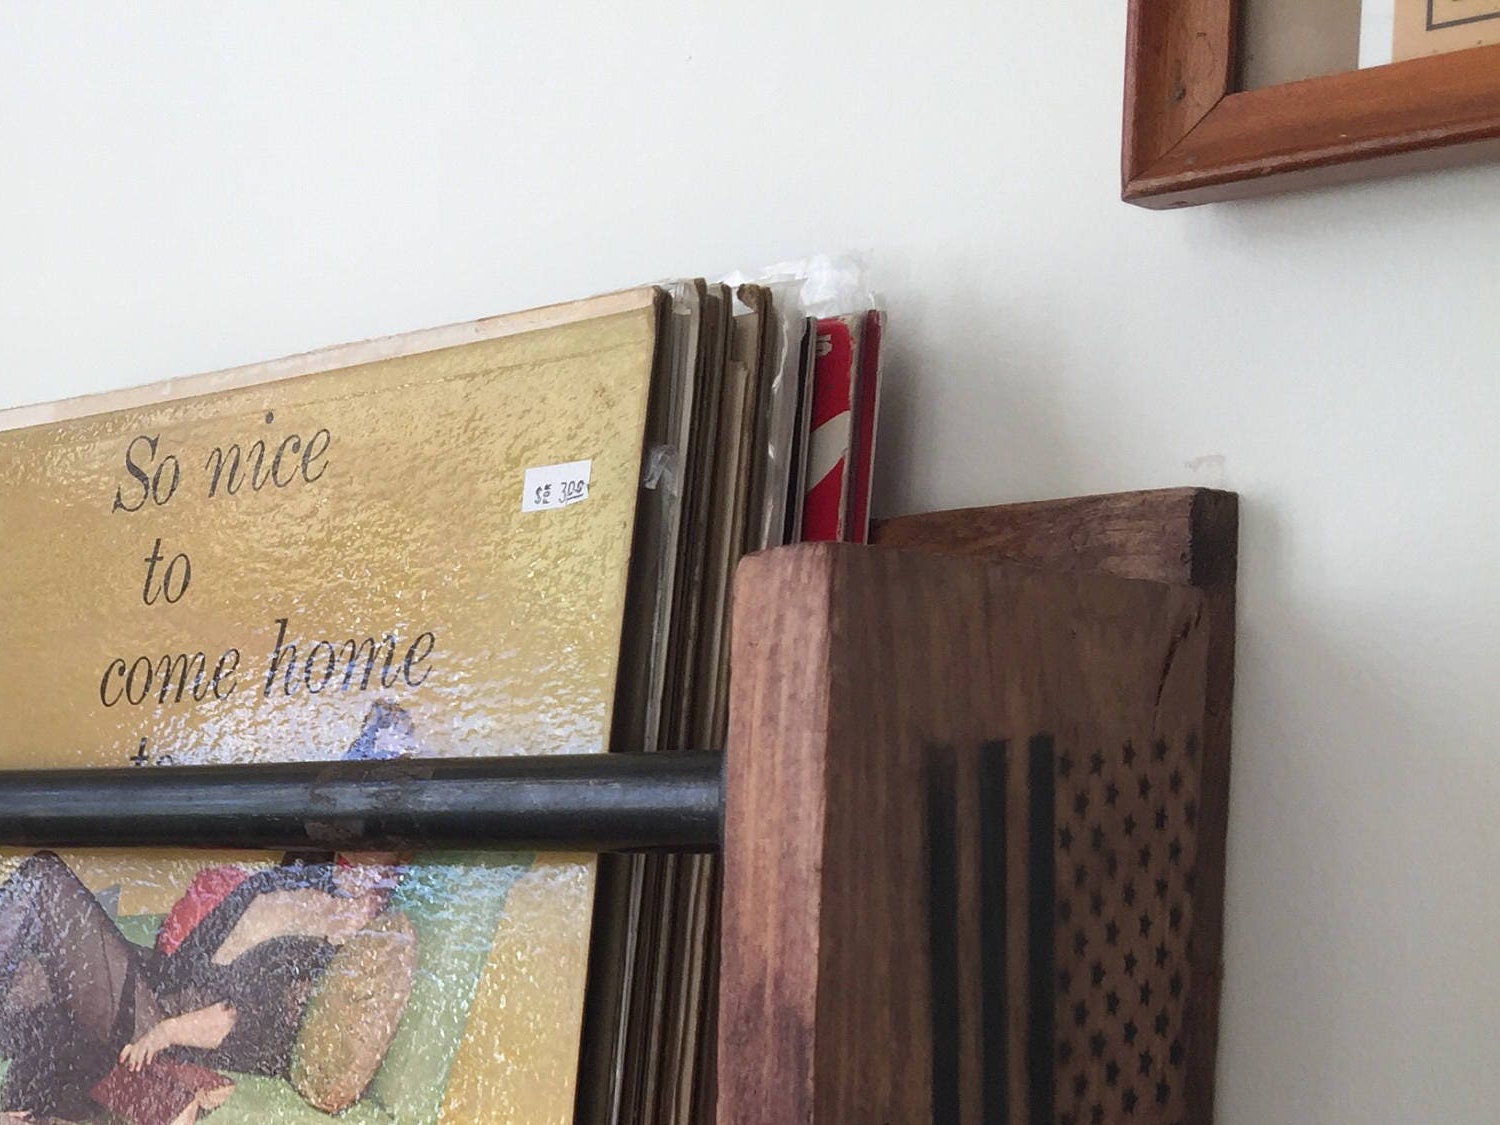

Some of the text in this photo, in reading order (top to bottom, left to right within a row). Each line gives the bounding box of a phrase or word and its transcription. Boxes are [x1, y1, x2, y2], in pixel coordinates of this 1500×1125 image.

[112, 411, 331, 512] So nice
[143, 537, 192, 605] to
[100, 618, 437, 707] come home
